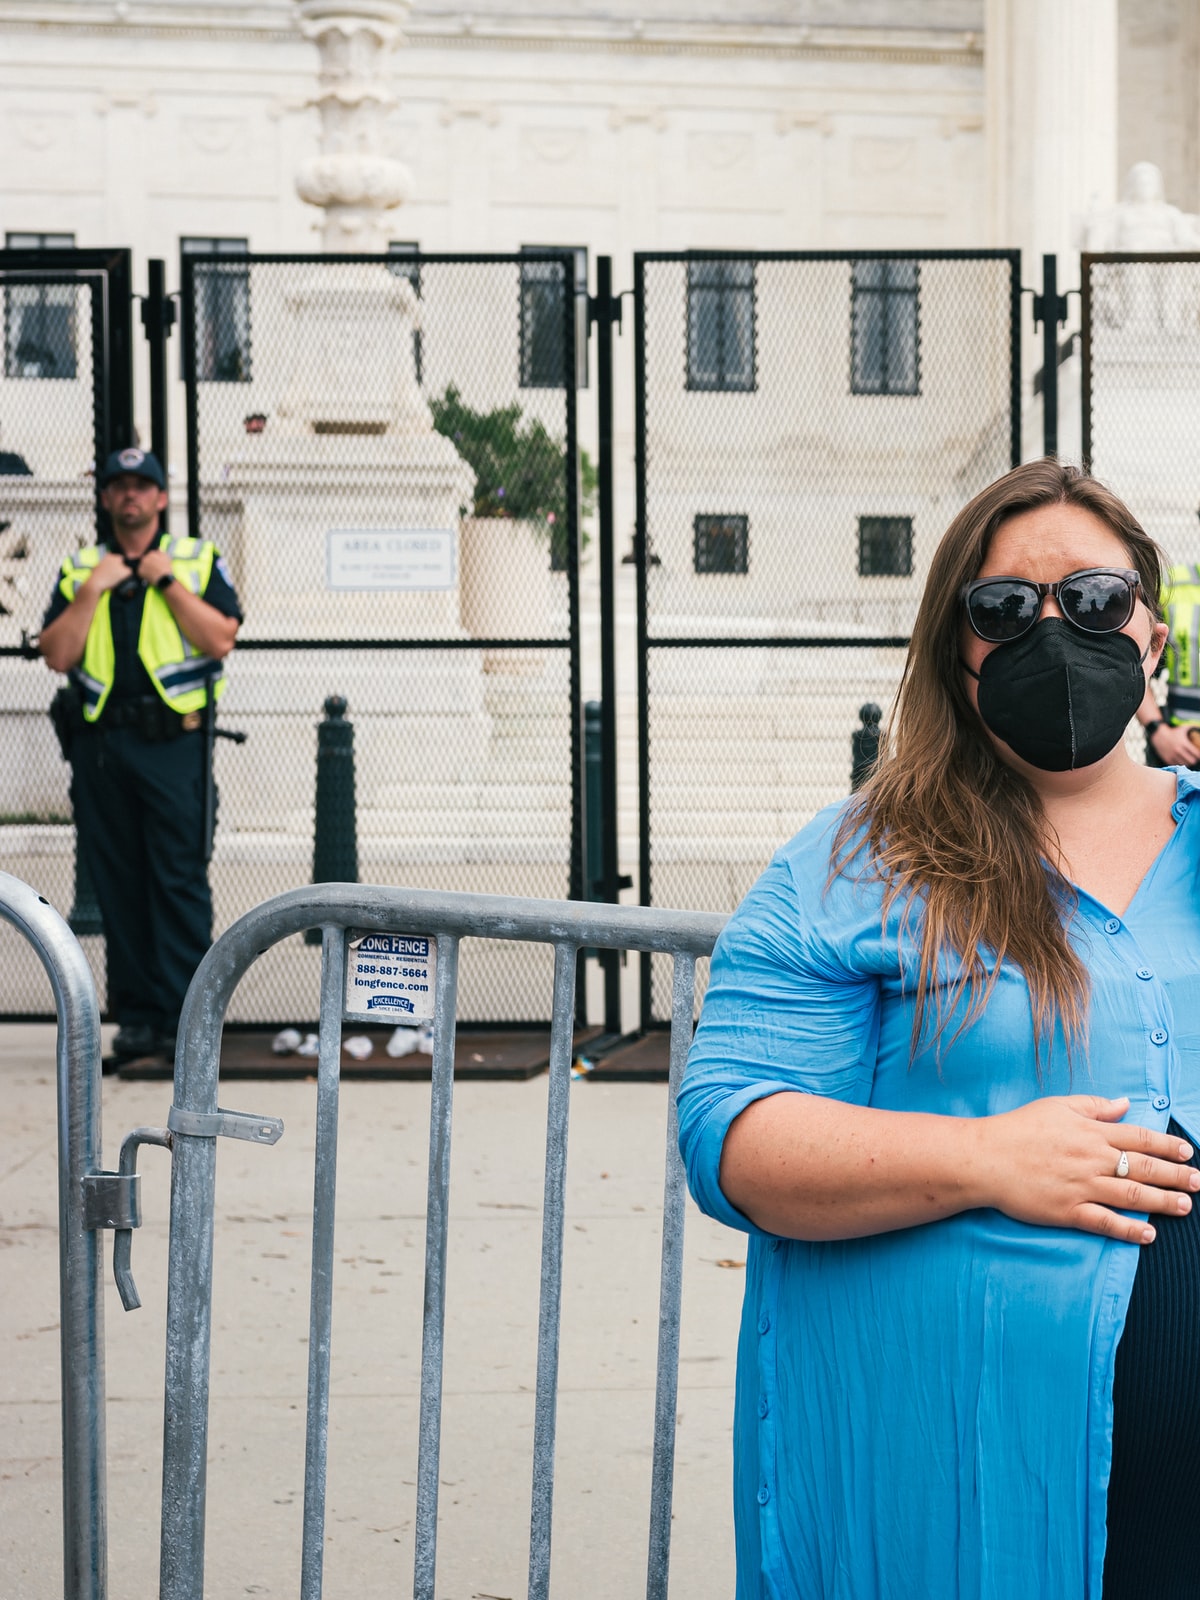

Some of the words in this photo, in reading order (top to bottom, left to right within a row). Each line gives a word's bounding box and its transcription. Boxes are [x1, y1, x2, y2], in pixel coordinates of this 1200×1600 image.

[392, 937, 426, 954] FENCE
[357, 964, 428, 978] 888-887-5664
[355, 977, 428, 991] longfence.com
[374, 997, 408, 1007] EXCELLENCE
